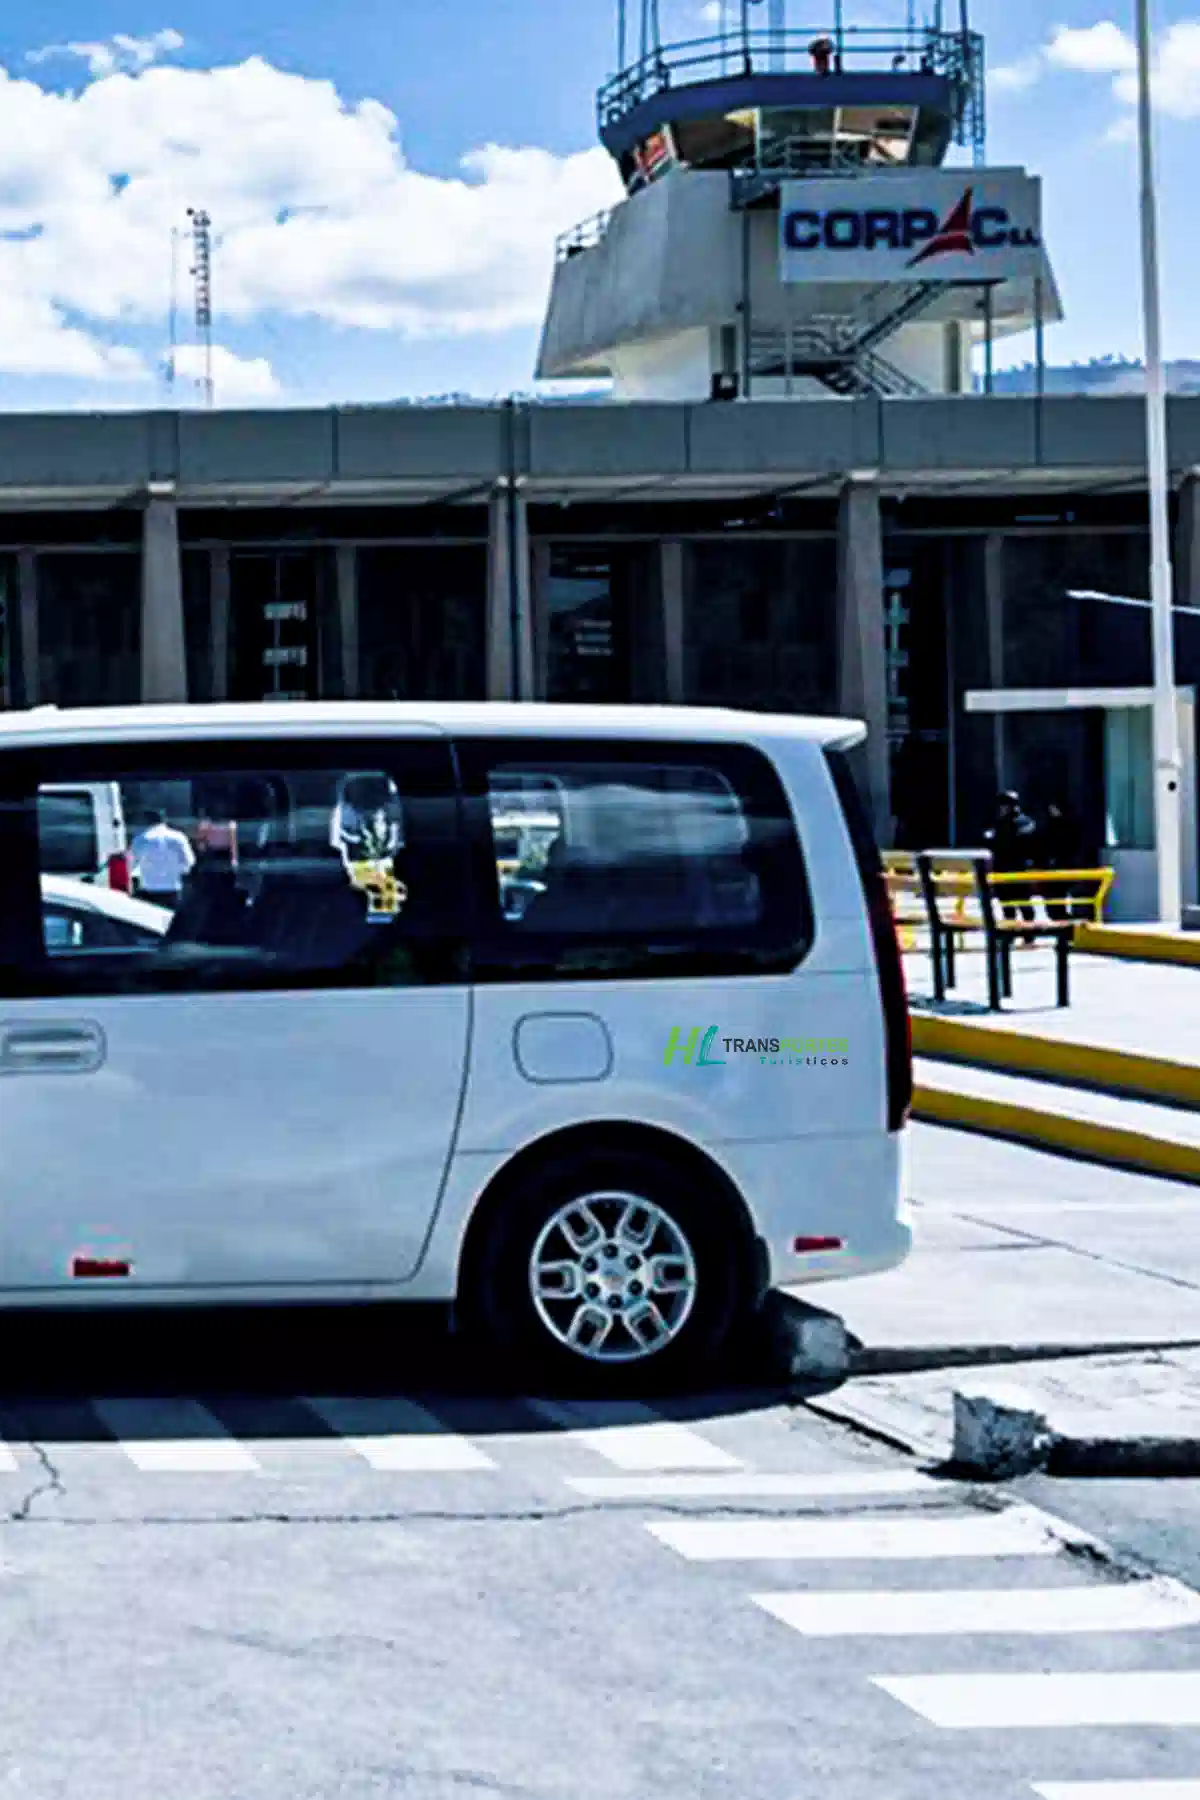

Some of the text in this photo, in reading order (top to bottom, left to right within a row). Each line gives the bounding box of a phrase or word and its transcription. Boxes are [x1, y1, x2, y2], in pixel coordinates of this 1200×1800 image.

[785, 188, 1009, 266] CORPAC
[664, 1025, 849, 1066] HL TRANSPORTES
